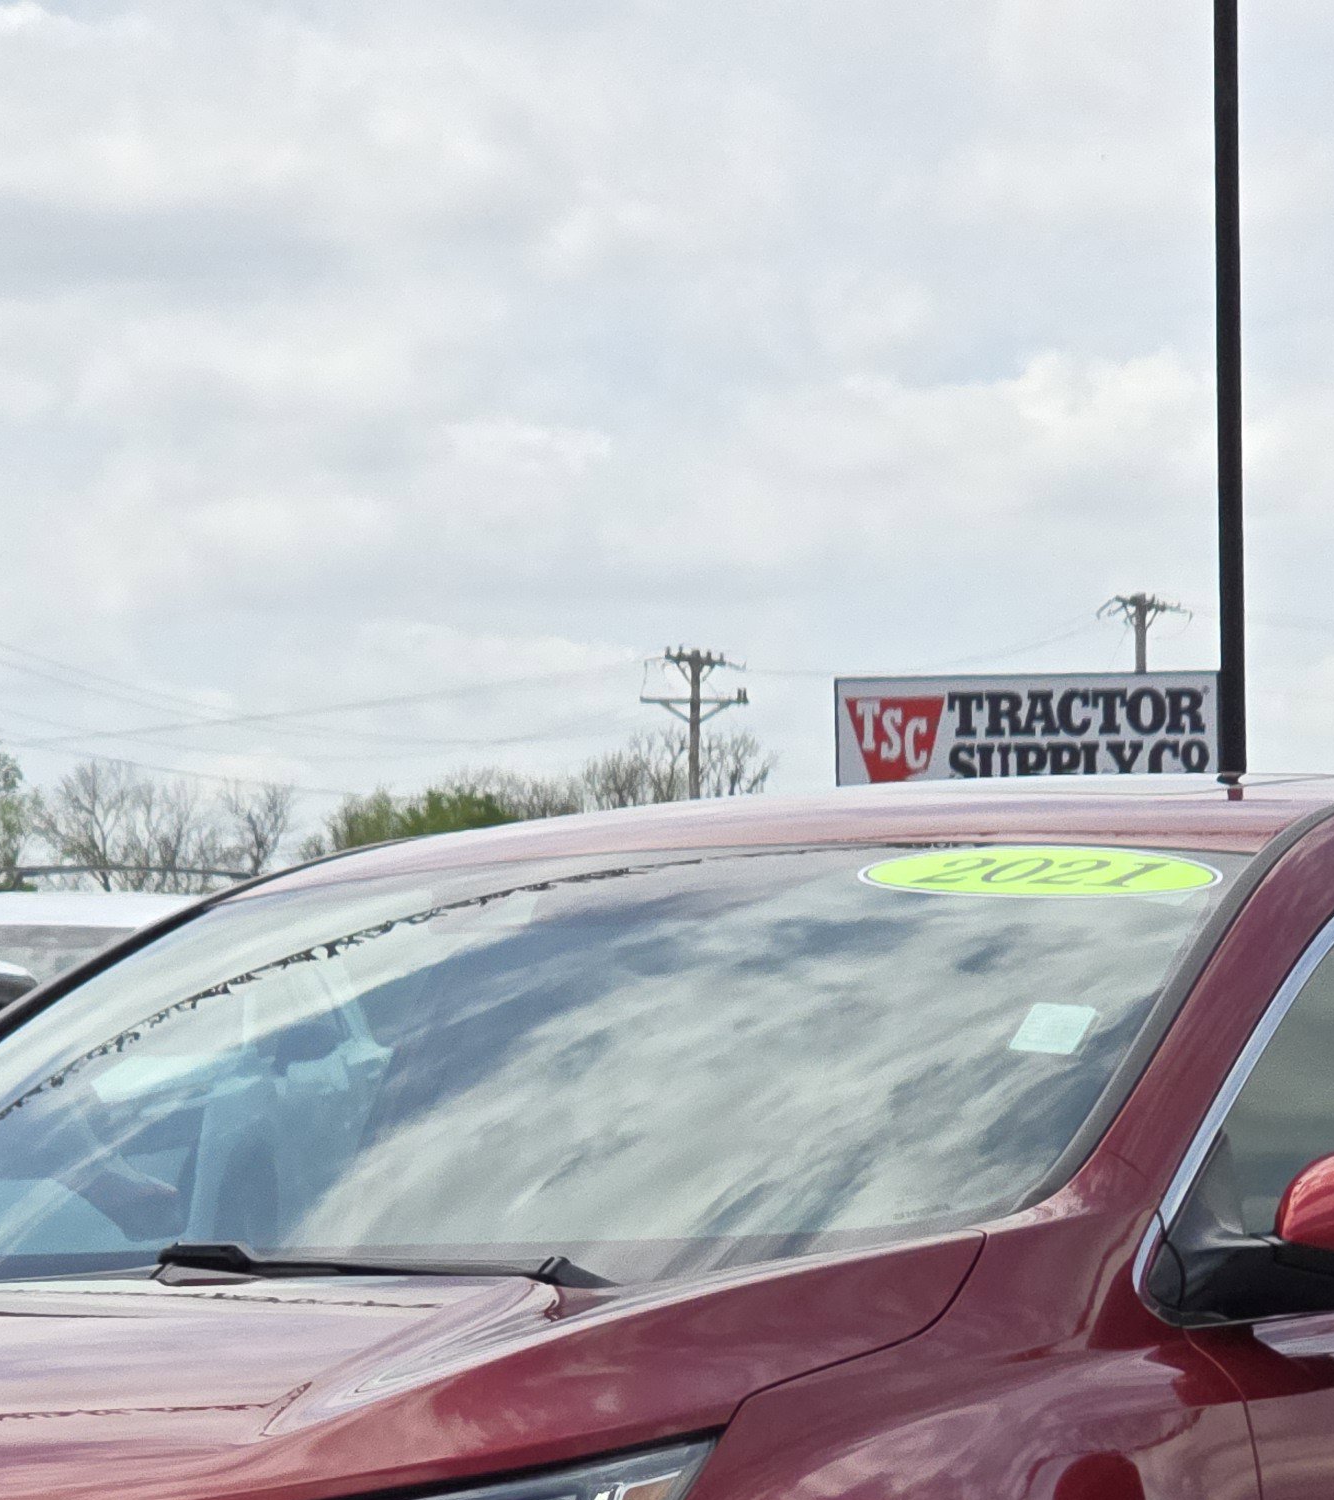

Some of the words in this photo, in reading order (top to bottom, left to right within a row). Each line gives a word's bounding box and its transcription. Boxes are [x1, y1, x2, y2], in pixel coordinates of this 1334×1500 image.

[856, 698, 928, 770] TSC
[947, 686, 1206, 737] TRACTOR
[913, 856, 1170, 888] 2021
